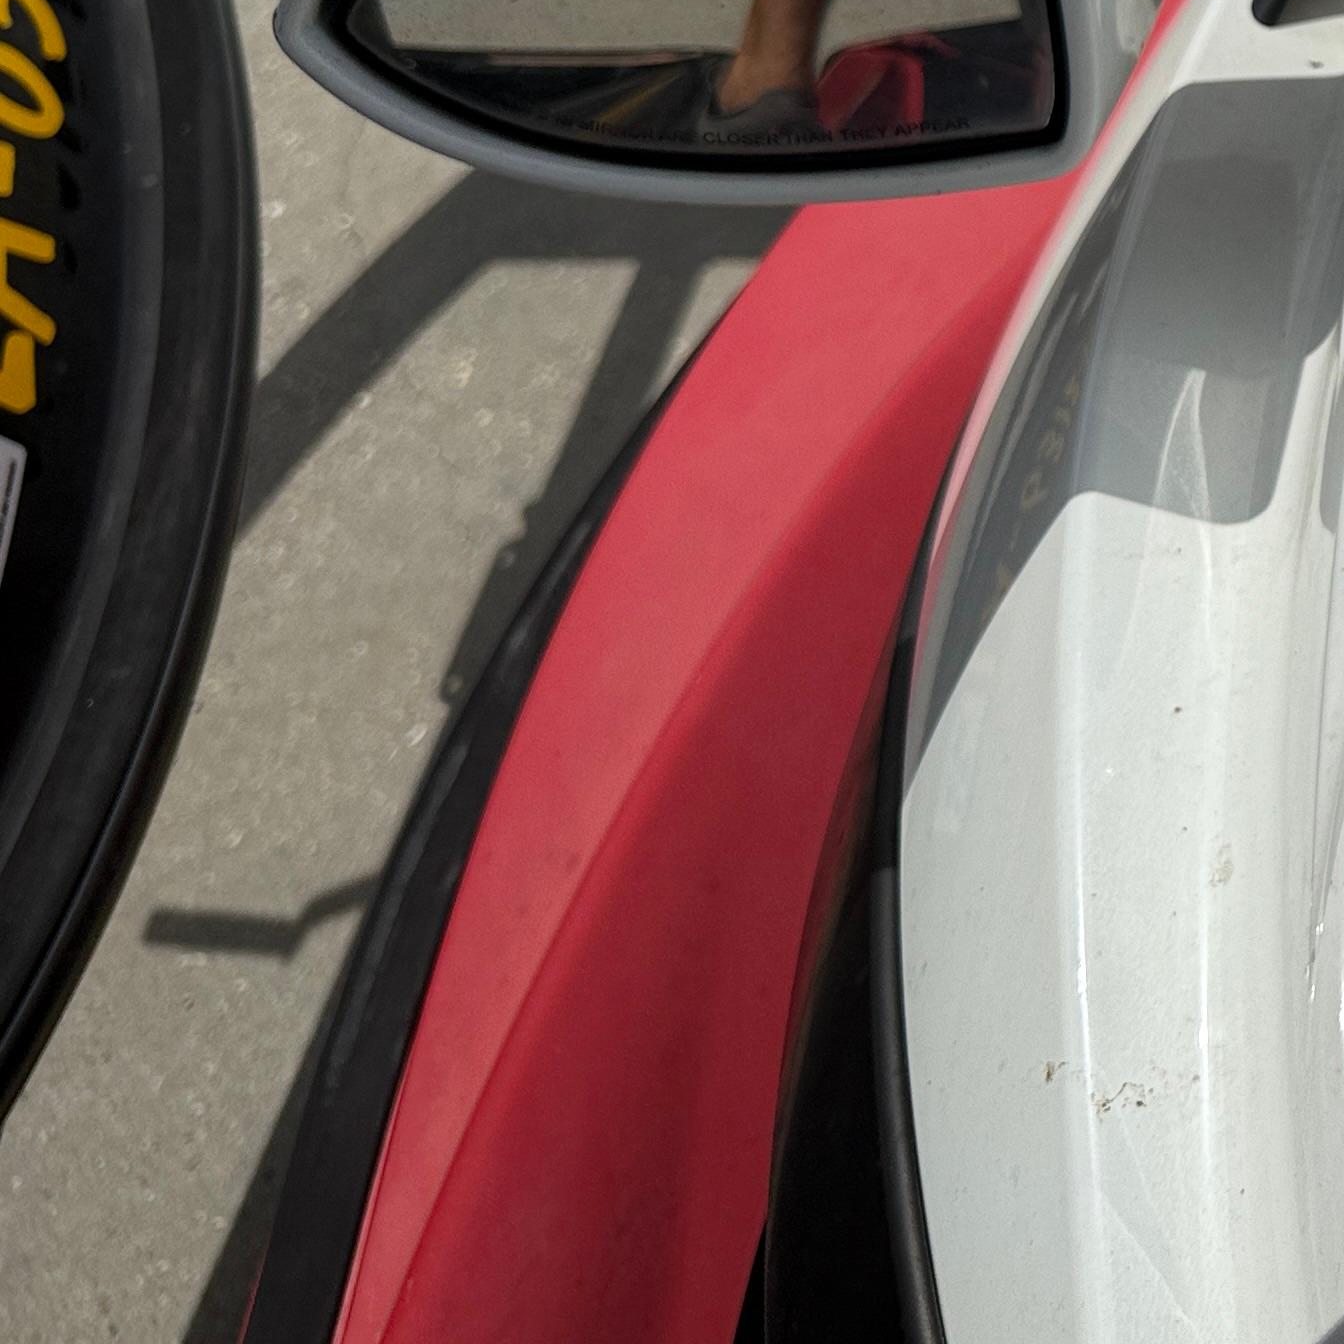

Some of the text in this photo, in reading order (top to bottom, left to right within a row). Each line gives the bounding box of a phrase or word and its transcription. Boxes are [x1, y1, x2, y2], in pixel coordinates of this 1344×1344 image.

[703, 130, 781, 146] CLOSER
[840, 126, 889, 142] THEY
[894, 117, 972, 137] APPEAR
